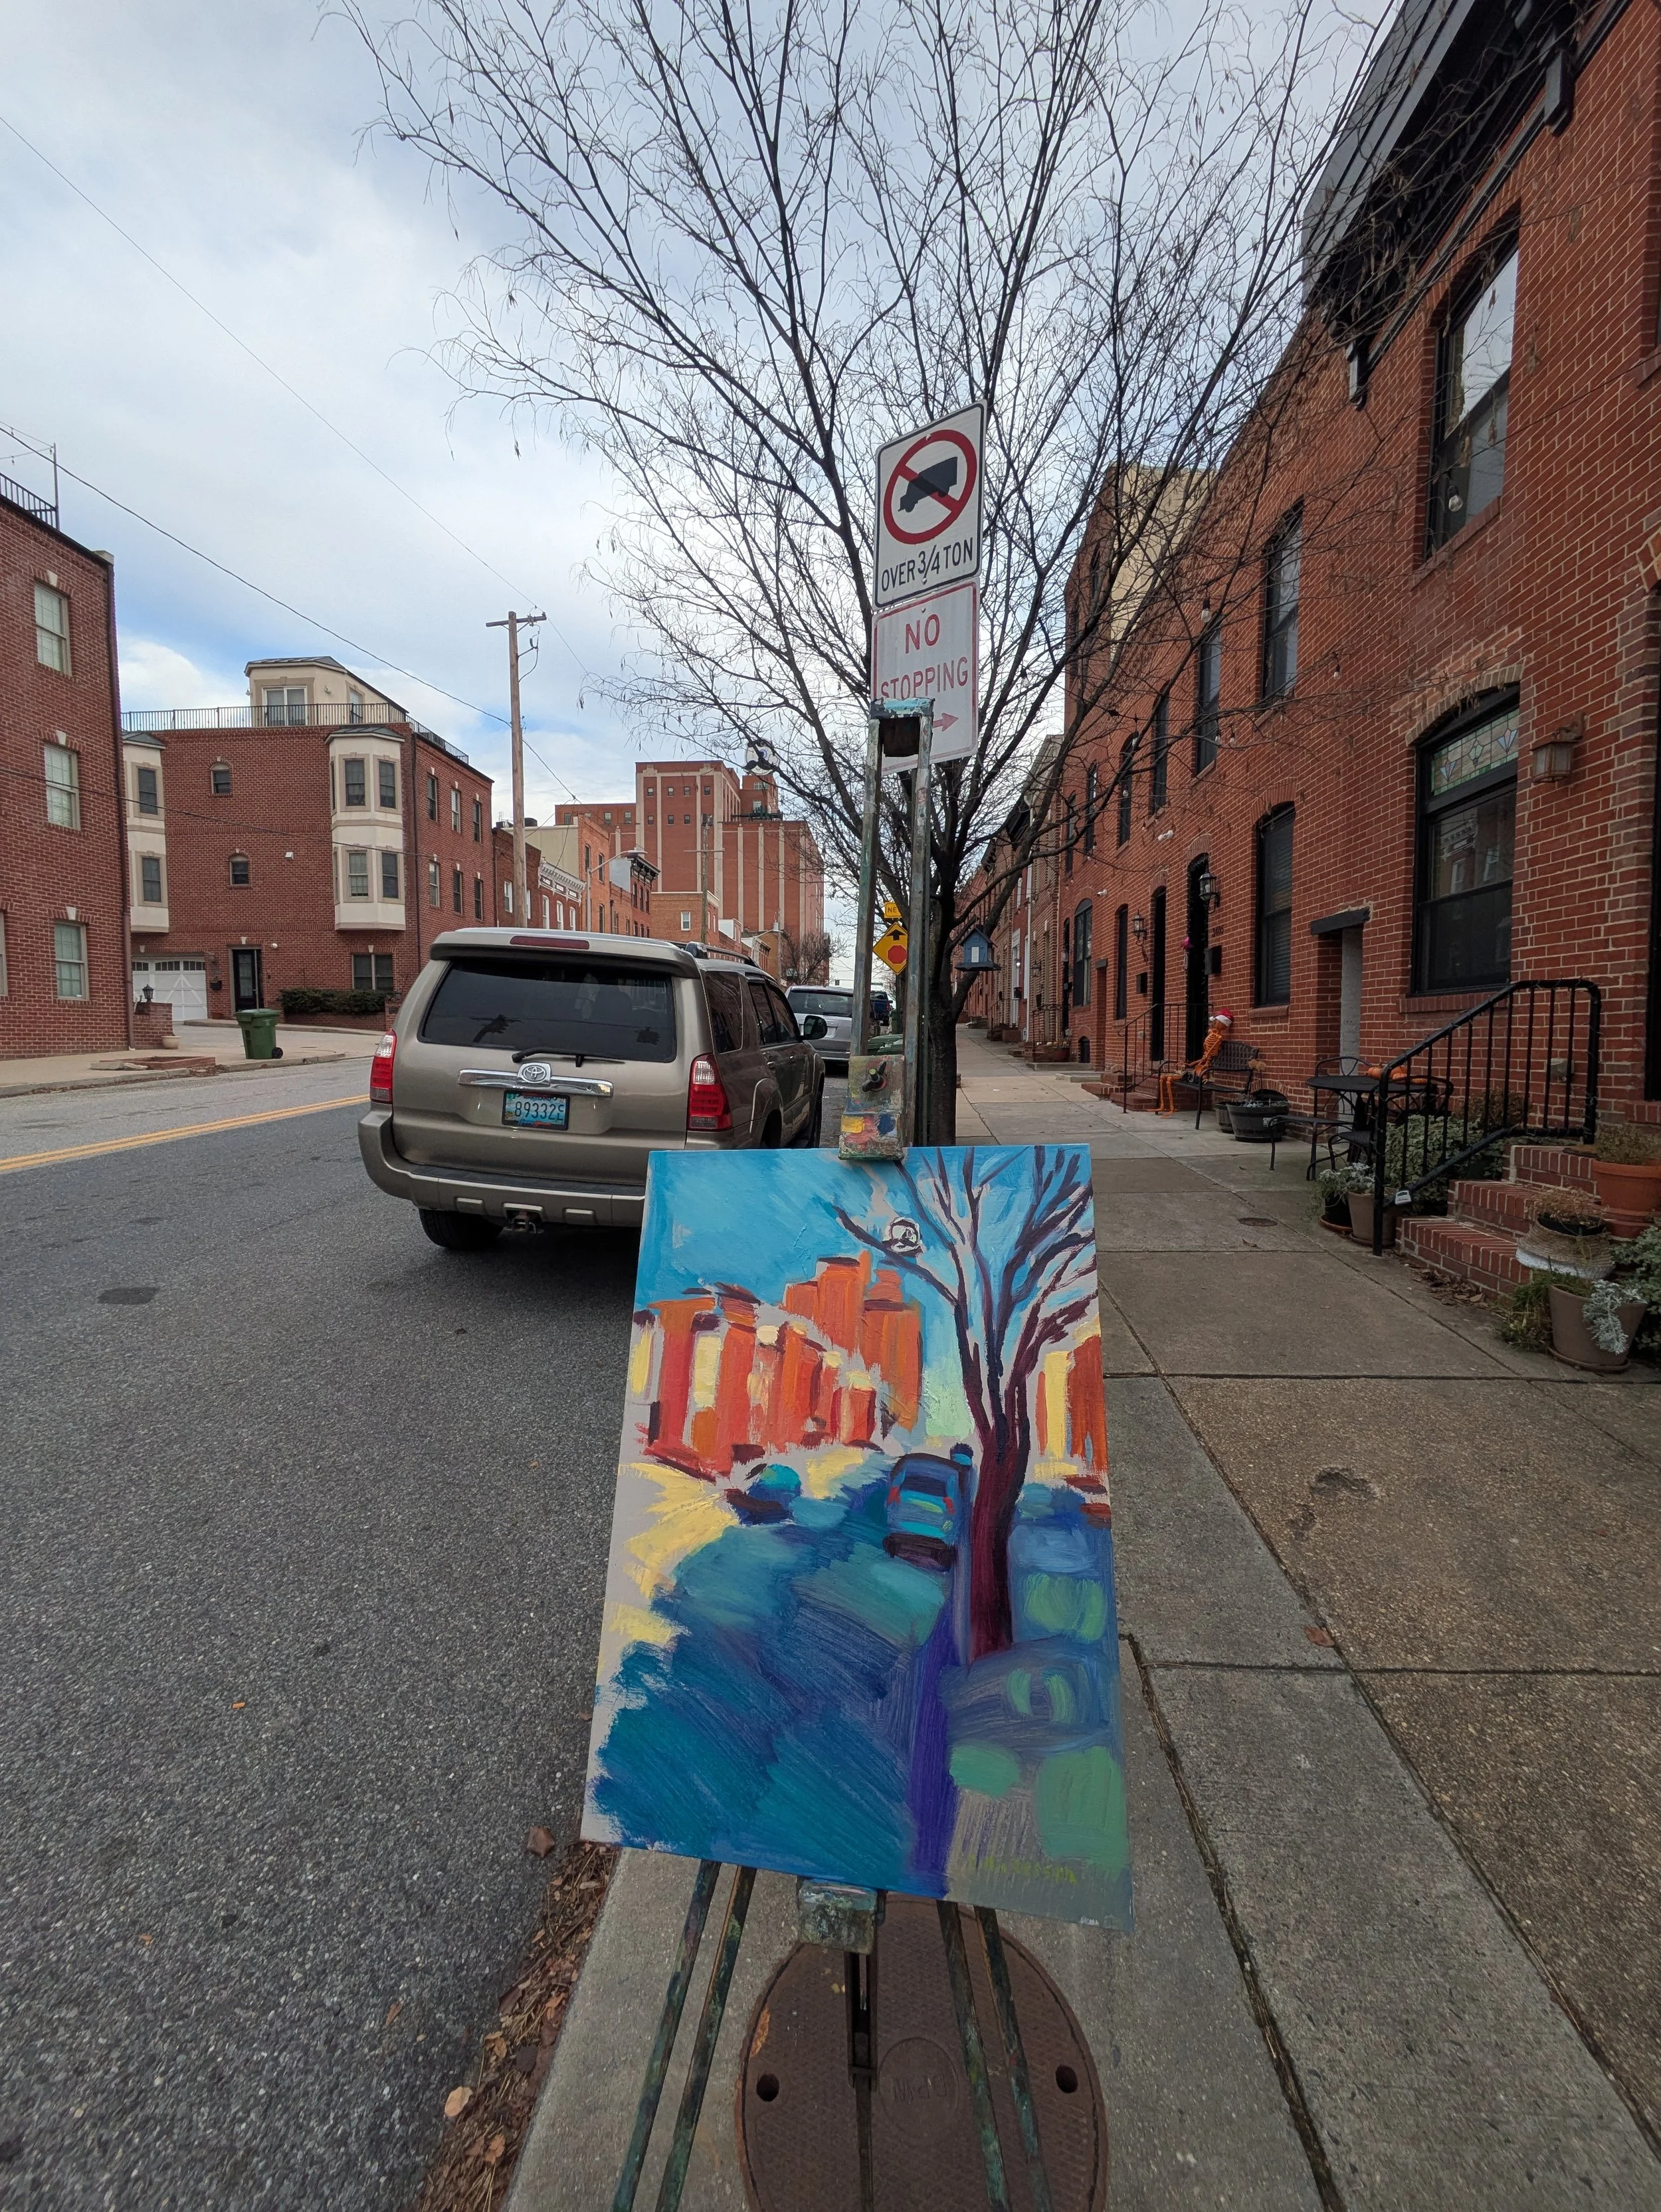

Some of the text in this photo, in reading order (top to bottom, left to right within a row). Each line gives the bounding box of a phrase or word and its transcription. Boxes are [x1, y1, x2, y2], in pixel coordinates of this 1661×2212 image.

[881, 559, 916, 591] OVER
[943, 537, 973, 569] TON
[905, 613, 940, 654] NO
[880, 656, 968, 699] STOPPING
